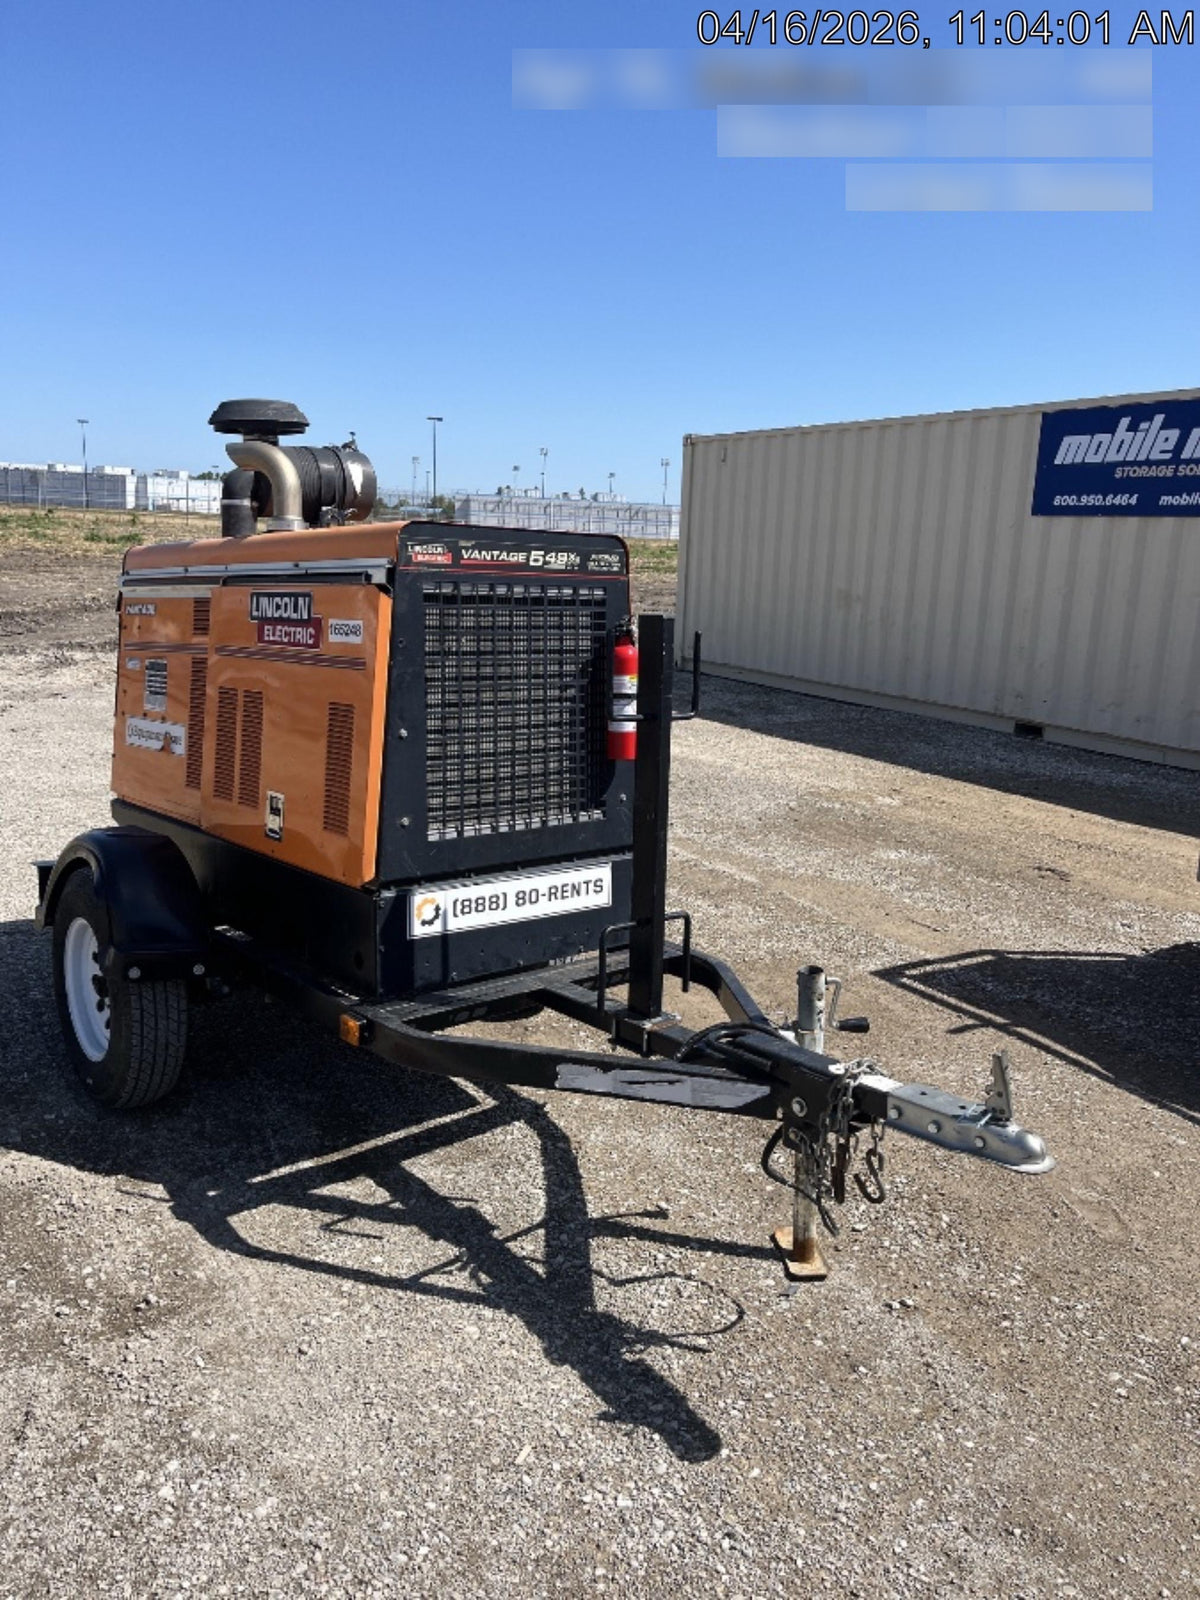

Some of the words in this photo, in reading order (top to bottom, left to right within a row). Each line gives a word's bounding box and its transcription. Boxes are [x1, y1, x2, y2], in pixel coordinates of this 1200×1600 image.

[1054, 414, 1181, 465] mobile
[1114, 465, 1175, 478] STORAGE
[1053, 494, 1139, 506] 800.950.6464
[461, 548, 527, 562] VANTAGE
[252, 594, 310, 619] LINCOLN
[263, 624, 316, 644] ELECTRIC
[452, 892, 508, 918] (888)
[515, 878, 604, 908] 80-RENTS
